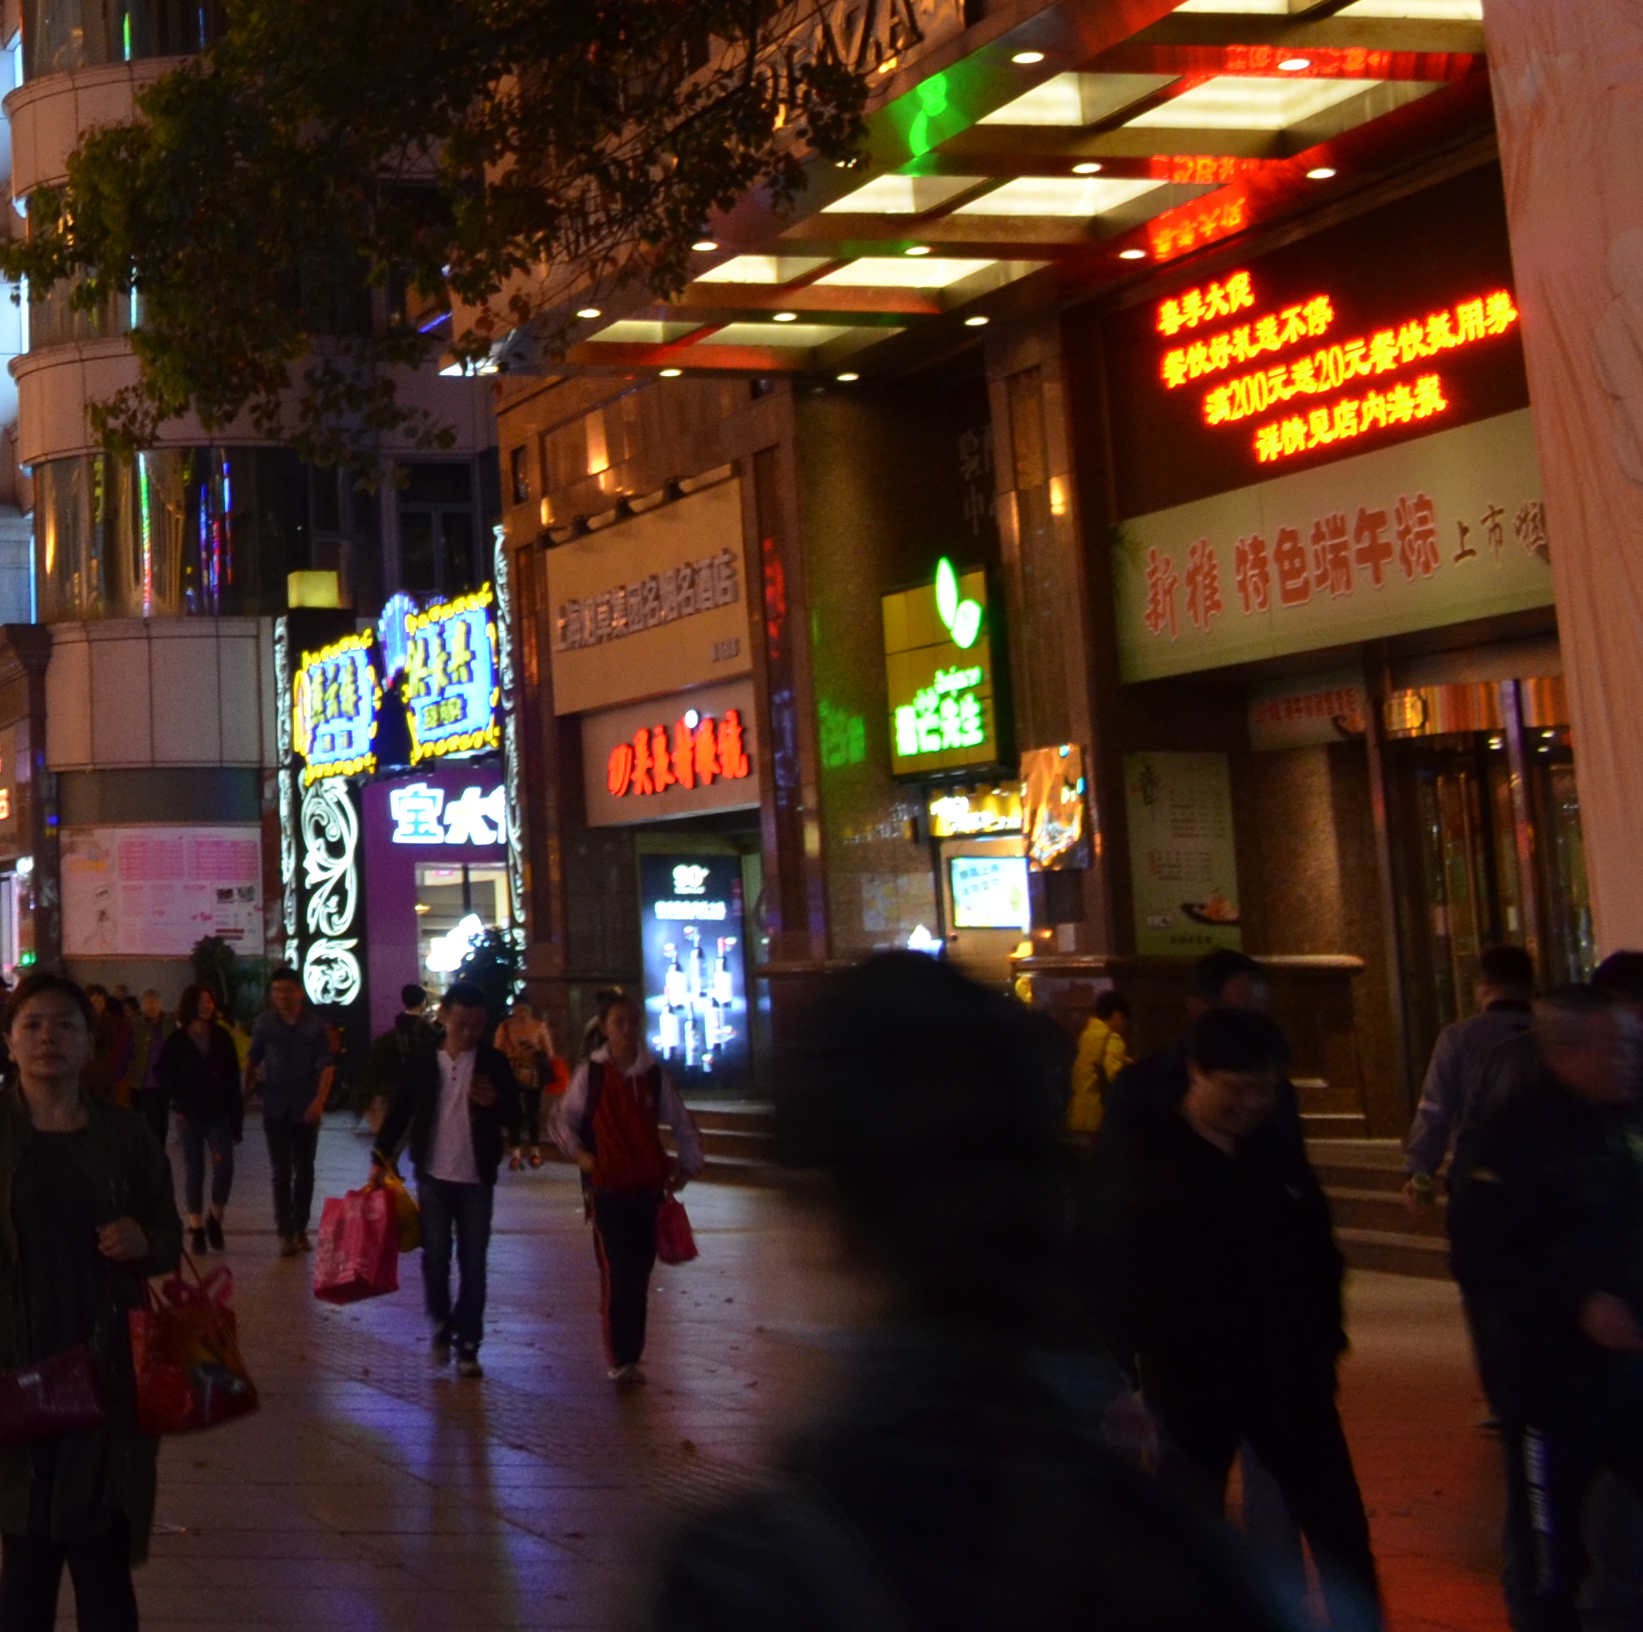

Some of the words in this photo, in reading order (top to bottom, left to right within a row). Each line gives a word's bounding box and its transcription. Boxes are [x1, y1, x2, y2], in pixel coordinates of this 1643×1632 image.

[1158, 270, 1255, 336] 春季大促
[1162, 294, 1335, 389] 餐饮好礼送不停
[1203, 288, 1519, 426] 满200元送20元餐饮抵用券
[1253, 372, 1448, 464] 详情见店内海报
[1144, 537, 1223, 642] 新雅
[1234, 492, 1441, 615] 特色端午粽
